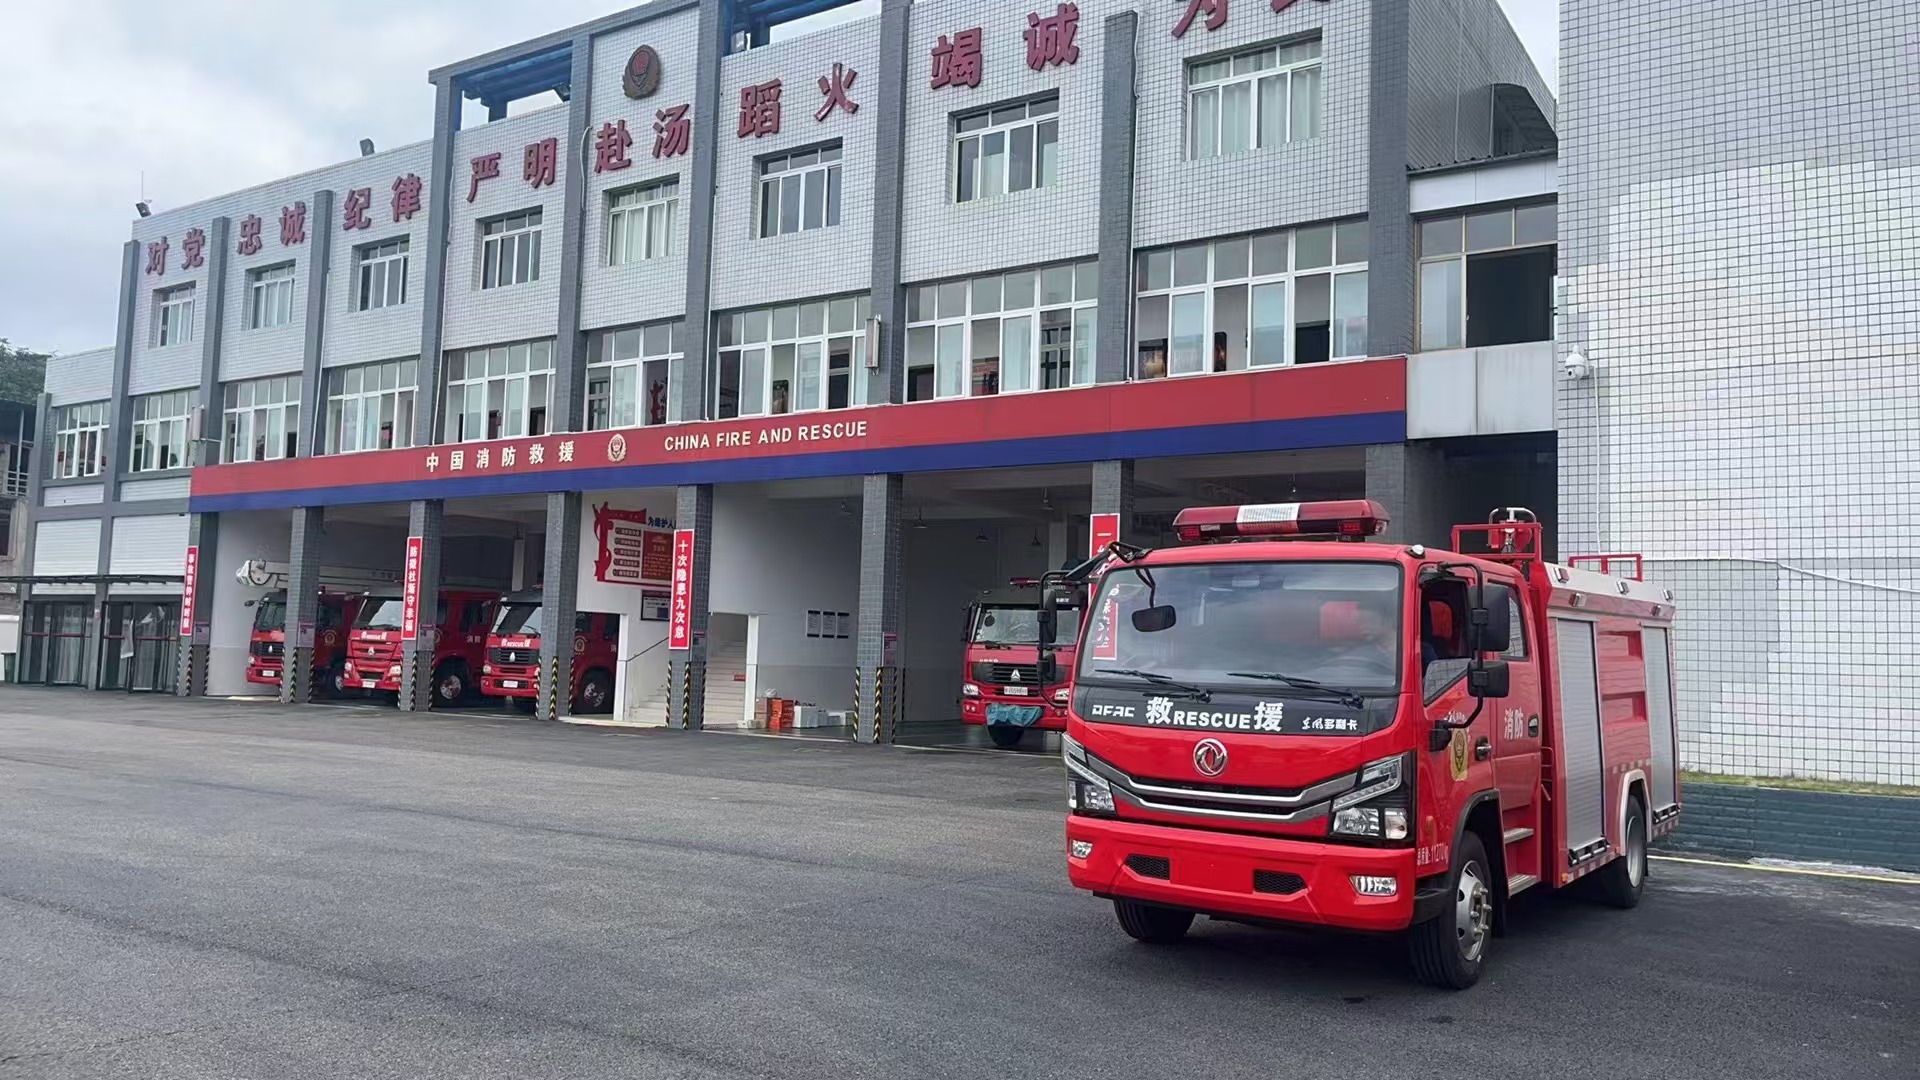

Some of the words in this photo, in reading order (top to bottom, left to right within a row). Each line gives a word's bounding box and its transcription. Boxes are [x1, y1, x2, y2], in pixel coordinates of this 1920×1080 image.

[664, 434, 710, 451] CHINA
[716, 430, 752, 447] FIRE
[758, 426, 792, 443] AND
[798, 420, 868, 441] RESCUE
[426, 440, 574, 473] 中国消防救援
[1504, 707, 1523, 740] 消防
